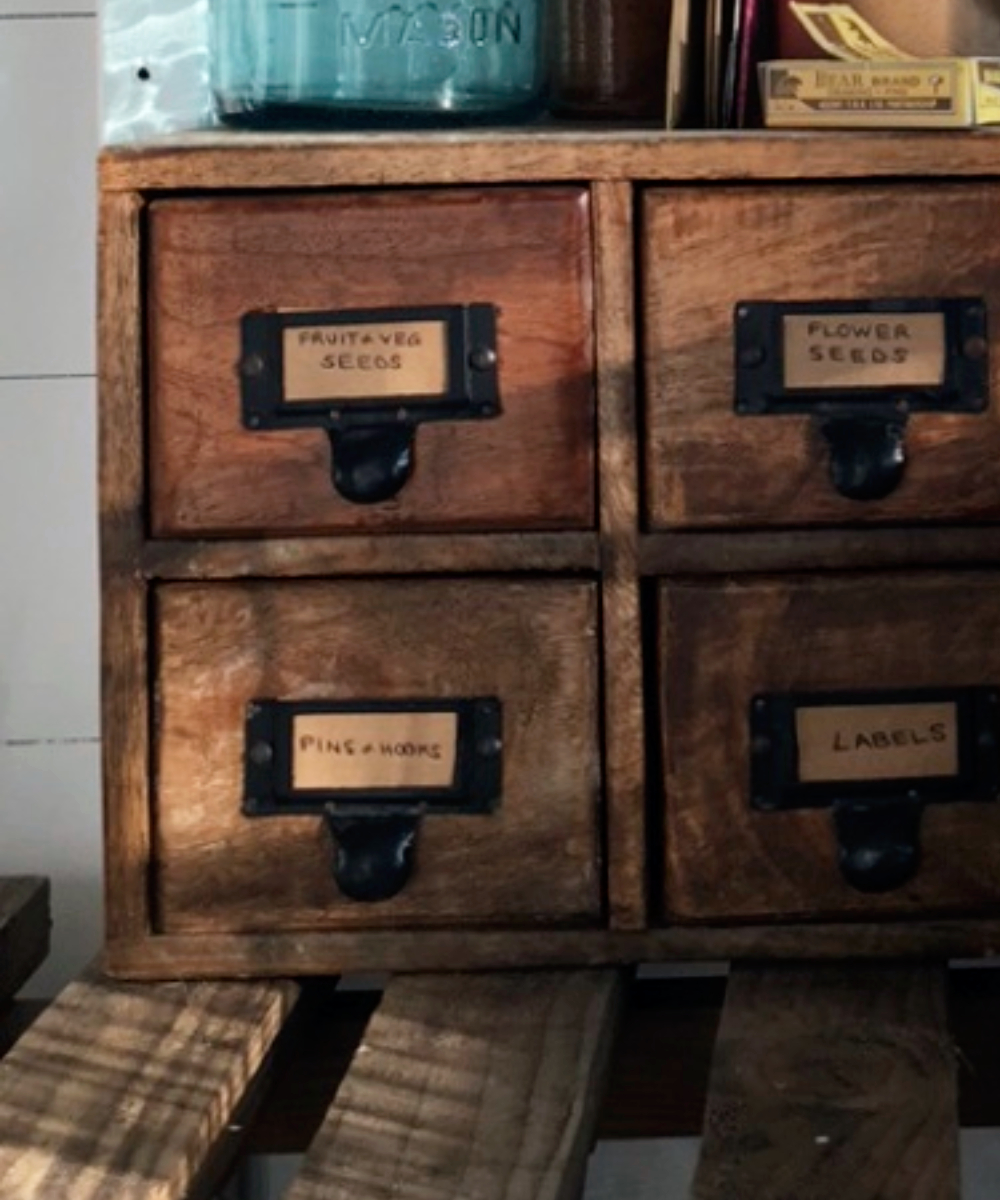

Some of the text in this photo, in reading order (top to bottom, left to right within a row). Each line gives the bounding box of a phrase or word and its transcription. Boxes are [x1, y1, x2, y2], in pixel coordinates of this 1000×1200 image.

[341, 5, 521, 48] MASON
[299, 330, 360, 347] FRUIT
[379, 330, 422, 347] VEG
[807, 319, 911, 340] FLOWER
[320, 353, 404, 370] SEEDS
[809, 345, 909, 364] SEEDS
[300, 733, 355, 756] PINS
[379, 740, 442, 760] HOOKS
[832, 722, 948, 753] LABELS
